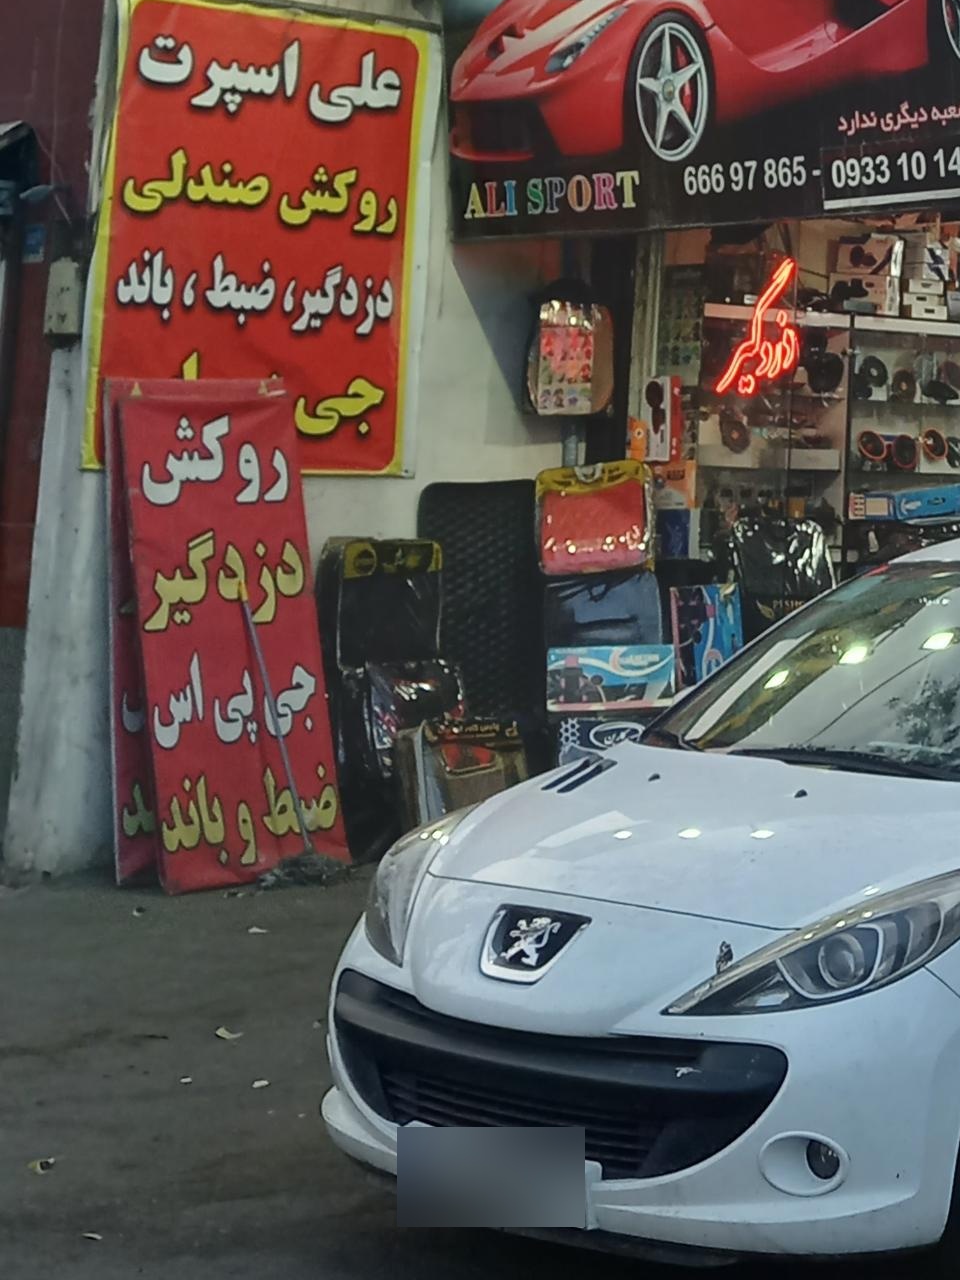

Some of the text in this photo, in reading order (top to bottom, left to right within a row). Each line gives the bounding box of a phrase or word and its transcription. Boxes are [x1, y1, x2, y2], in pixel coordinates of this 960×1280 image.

[138, 35, 401, 123] علی اسپرت
[837, 112, 878, 138] ندارد
[881, 106, 928, 136] دیگری
[123, 148, 398, 233] روکش صندلی
[464, 170, 640, 219] ALI SPORT
[683, 161, 725, 196] 666
[731, 159, 759, 192] 97
[831, 153, 891, 189] 0933
[896, 150, 928, 183] 10
[116, 249, 174, 320] باند
[716, 258, 797, 394] دزدگیر
[295, 376, 386, 436] جی
[141, 415, 289, 506] روکش
[143, 529, 305, 632] دزدگیر
[153, 652, 204, 749] اس
[213, 669, 255, 744] پی
[265, 664, 317, 737] جی
[161, 774, 227, 865] باند
[237, 801, 258, 867] و
[262, 764, 338, 838] ضبط
